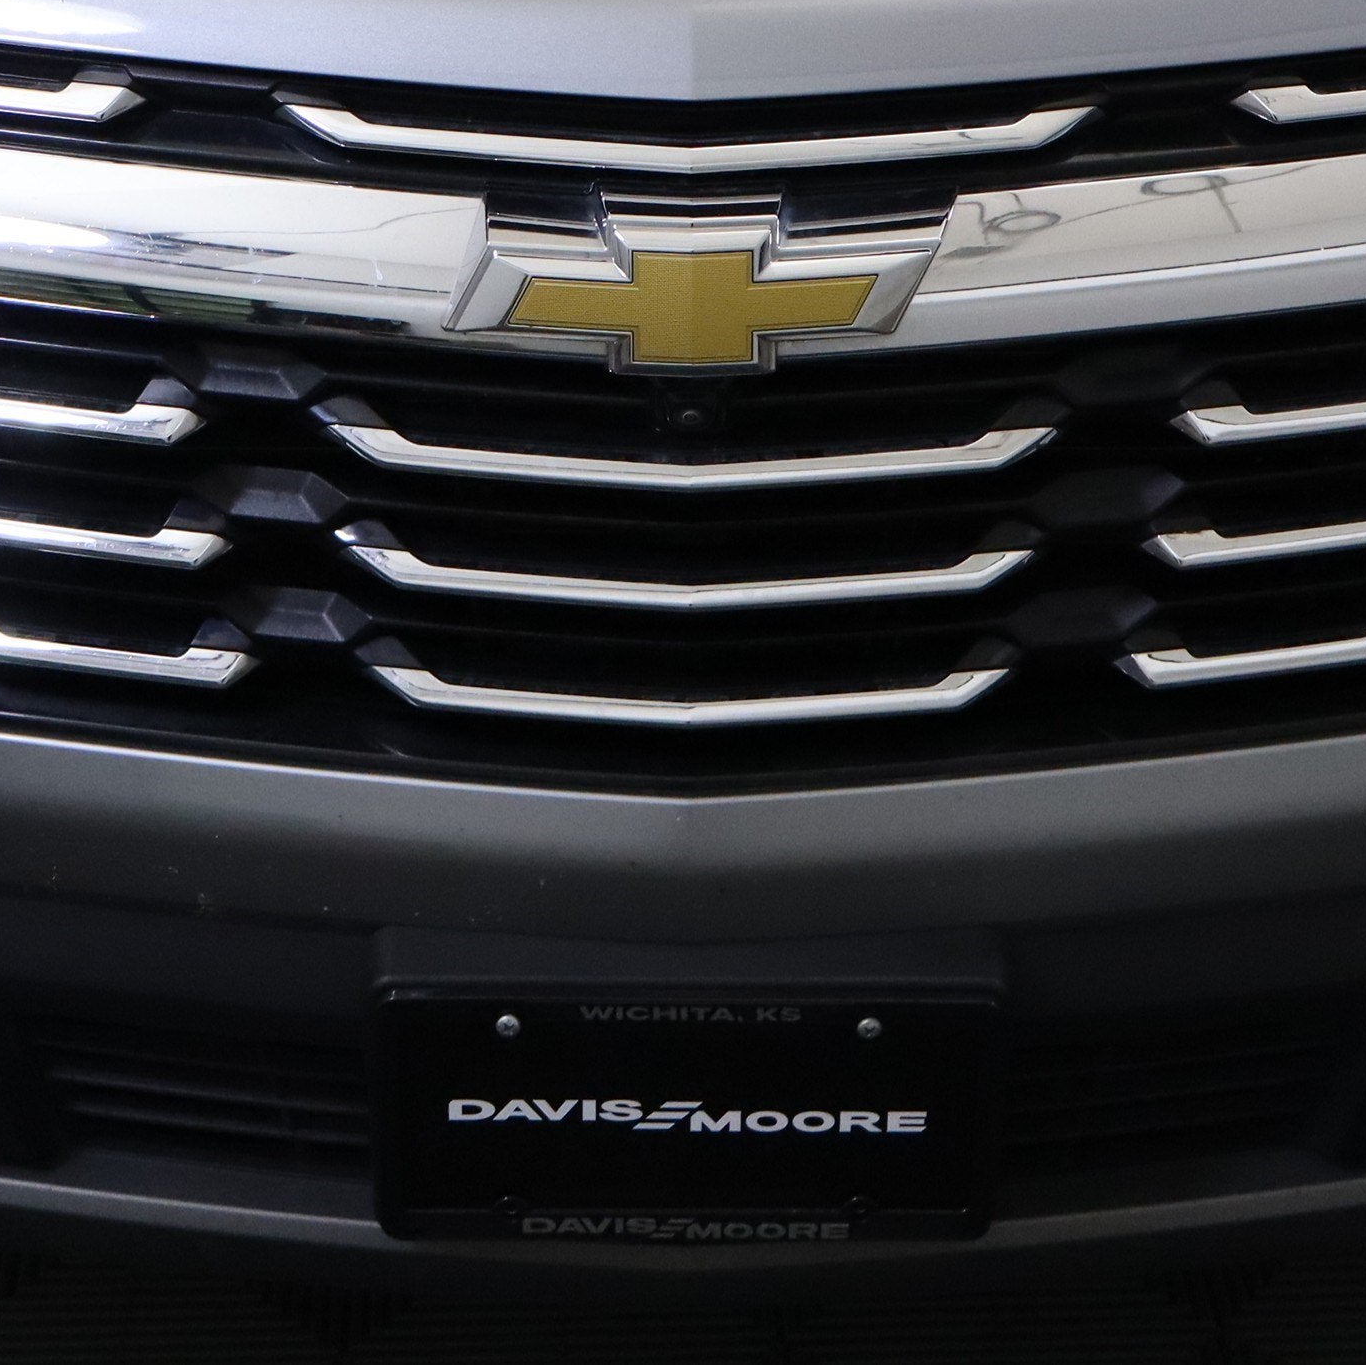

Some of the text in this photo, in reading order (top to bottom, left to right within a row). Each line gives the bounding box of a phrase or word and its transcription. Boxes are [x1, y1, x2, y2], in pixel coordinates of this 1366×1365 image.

[580, 1005, 801, 1022] WICHITA, KS
[448, 1099, 928, 1133] DAVIS MOORE
[522, 1217, 850, 1240] DAVIS MOORE
